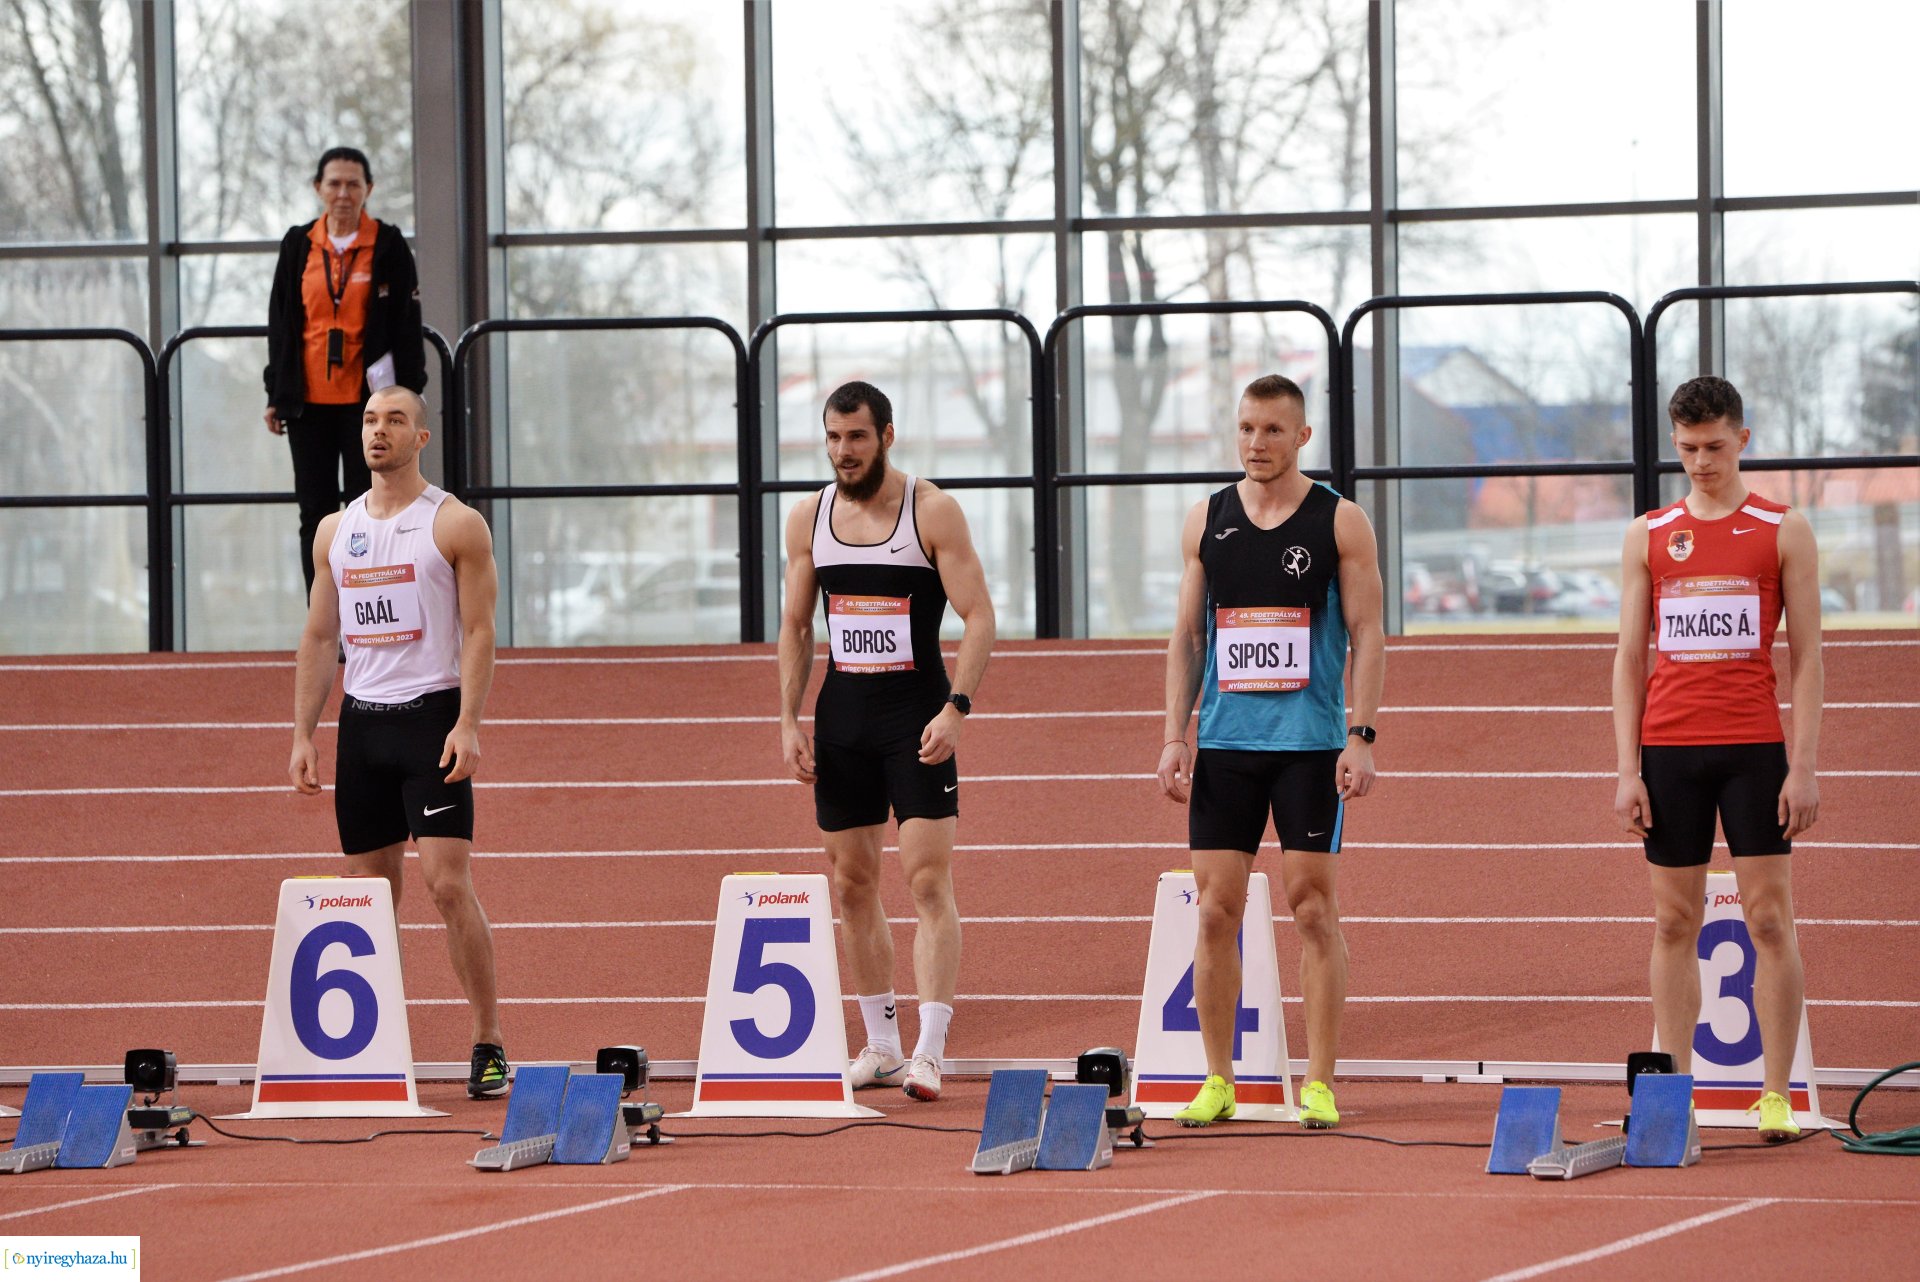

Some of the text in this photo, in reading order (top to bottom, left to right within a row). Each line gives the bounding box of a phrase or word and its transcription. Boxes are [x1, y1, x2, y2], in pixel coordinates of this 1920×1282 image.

[354, 595, 400, 626] GAÁL
[1250, 611, 1302, 619] FEDETTPÁLYÁS
[1665, 608, 1756, 638] TAKÁCS Á.
[396, 633, 414, 641] 2023
[842, 629, 897, 654] BOROS
[1228, 642, 1298, 670] SIPOS J.
[1670, 651, 1729, 661] NYÍREGYHÁZA
[1228, 681, 1301, 690] NYÍREGYHÁZA 2023
[319, 894, 373, 910] polanik
[758, 891, 811, 907] polanik
[290, 920, 379, 1060] 6
[729, 917, 816, 1060] 5
[1692, 918, 1764, 1067] 3
